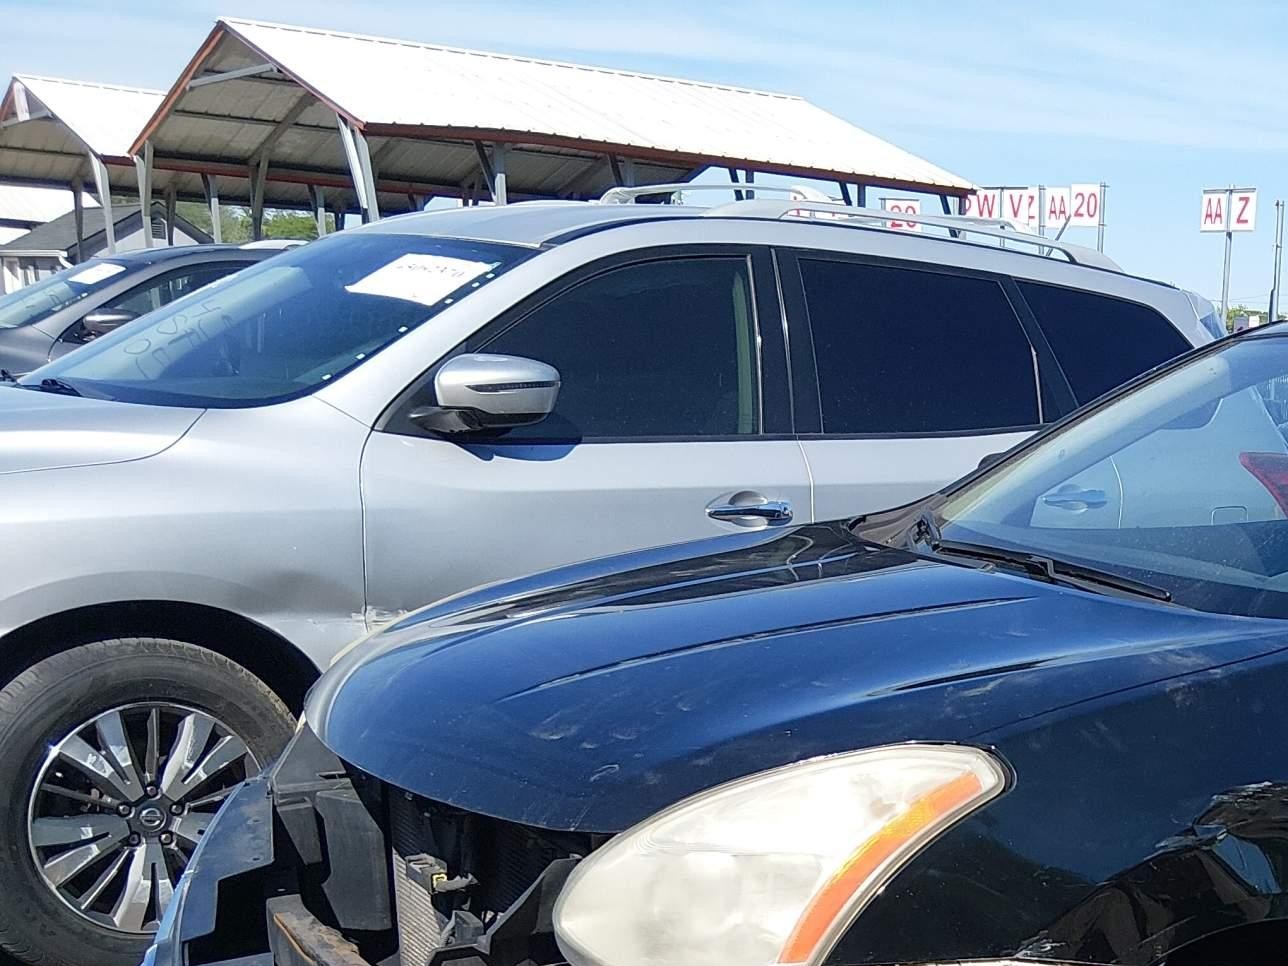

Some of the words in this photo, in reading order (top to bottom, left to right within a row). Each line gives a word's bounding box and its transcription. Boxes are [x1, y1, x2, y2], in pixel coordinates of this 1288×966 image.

[977, 194, 996, 218] W
[1009, 194, 1023, 218] V
[1048, 195, 1066, 220] AA
[1074, 192, 1098, 218] 20
[1204, 197, 1223, 225] AA
[1236, 196, 1250, 224] Z
